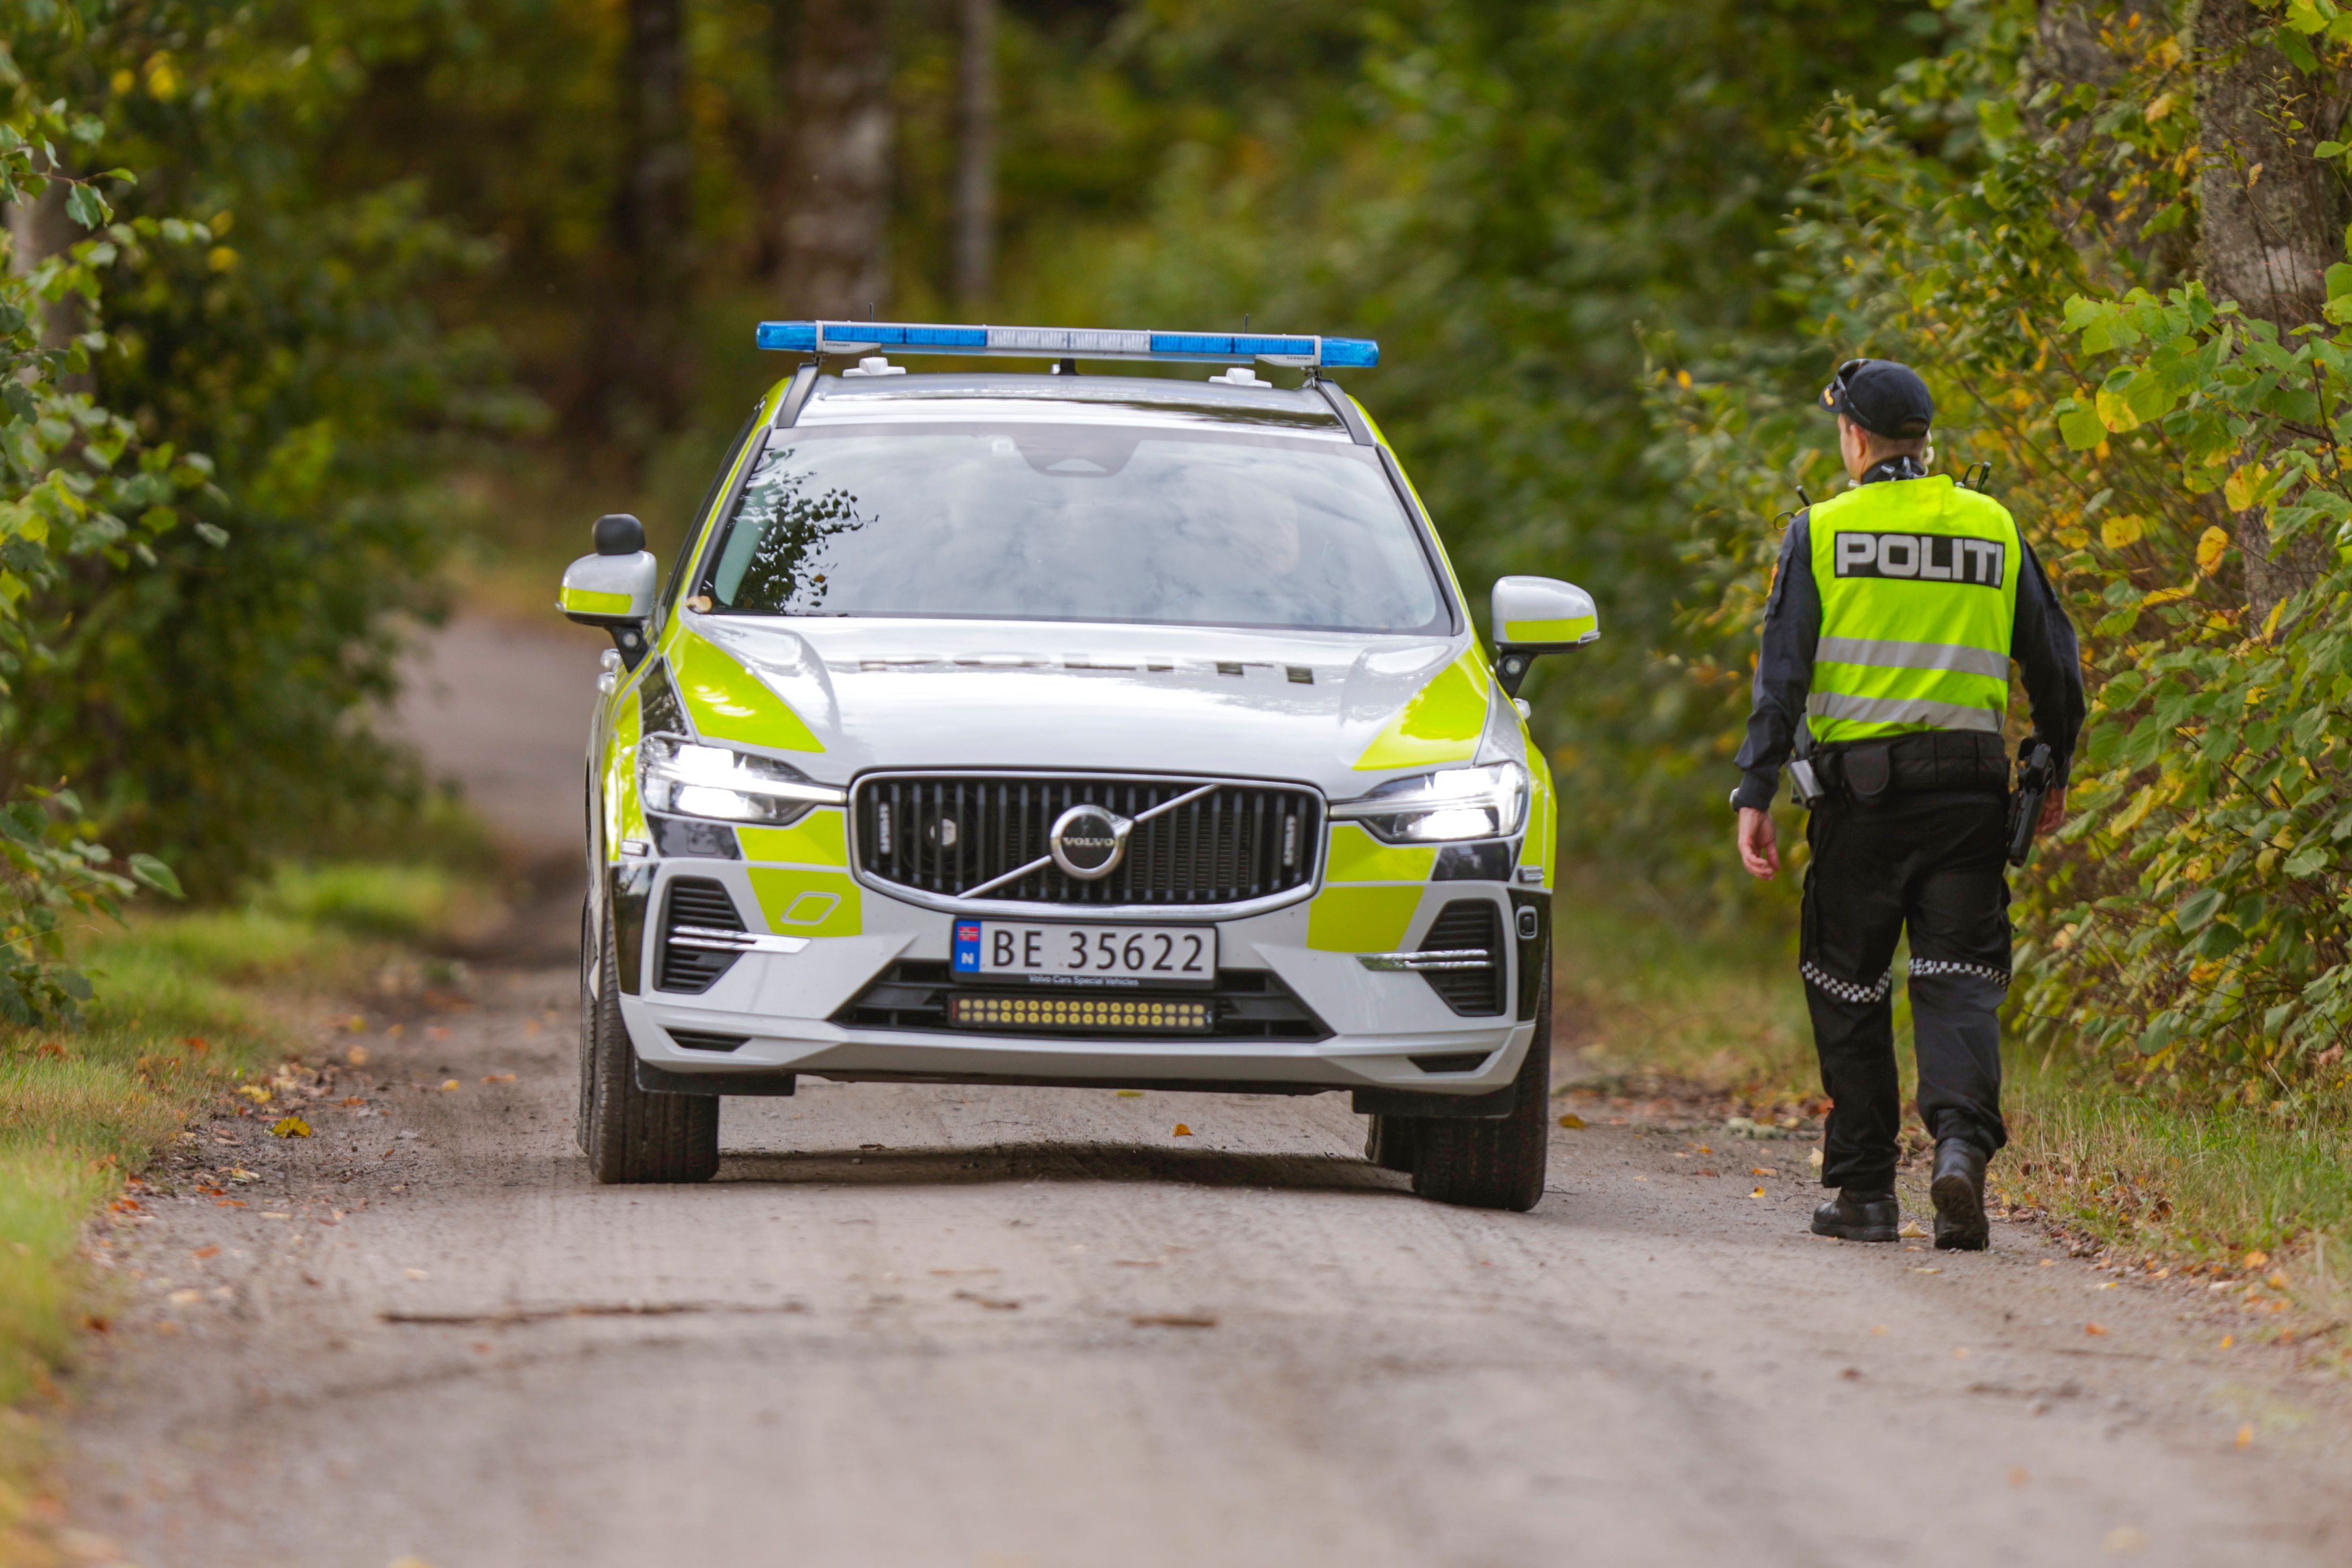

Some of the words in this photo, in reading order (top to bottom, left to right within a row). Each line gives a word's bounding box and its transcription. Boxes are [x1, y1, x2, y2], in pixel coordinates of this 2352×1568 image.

[1836, 533, 2003, 587] POLITI
[1062, 837, 1114, 847] VOLVO
[993, 929, 1042, 968] BE
[1067, 931, 1203, 971] 35622
[961, 952, 974, 964] N
[1052, 975, 1072, 983] Cars
[1073, 976, 1103, 986] Special
[1104, 977, 1139, 986] Vehicles
